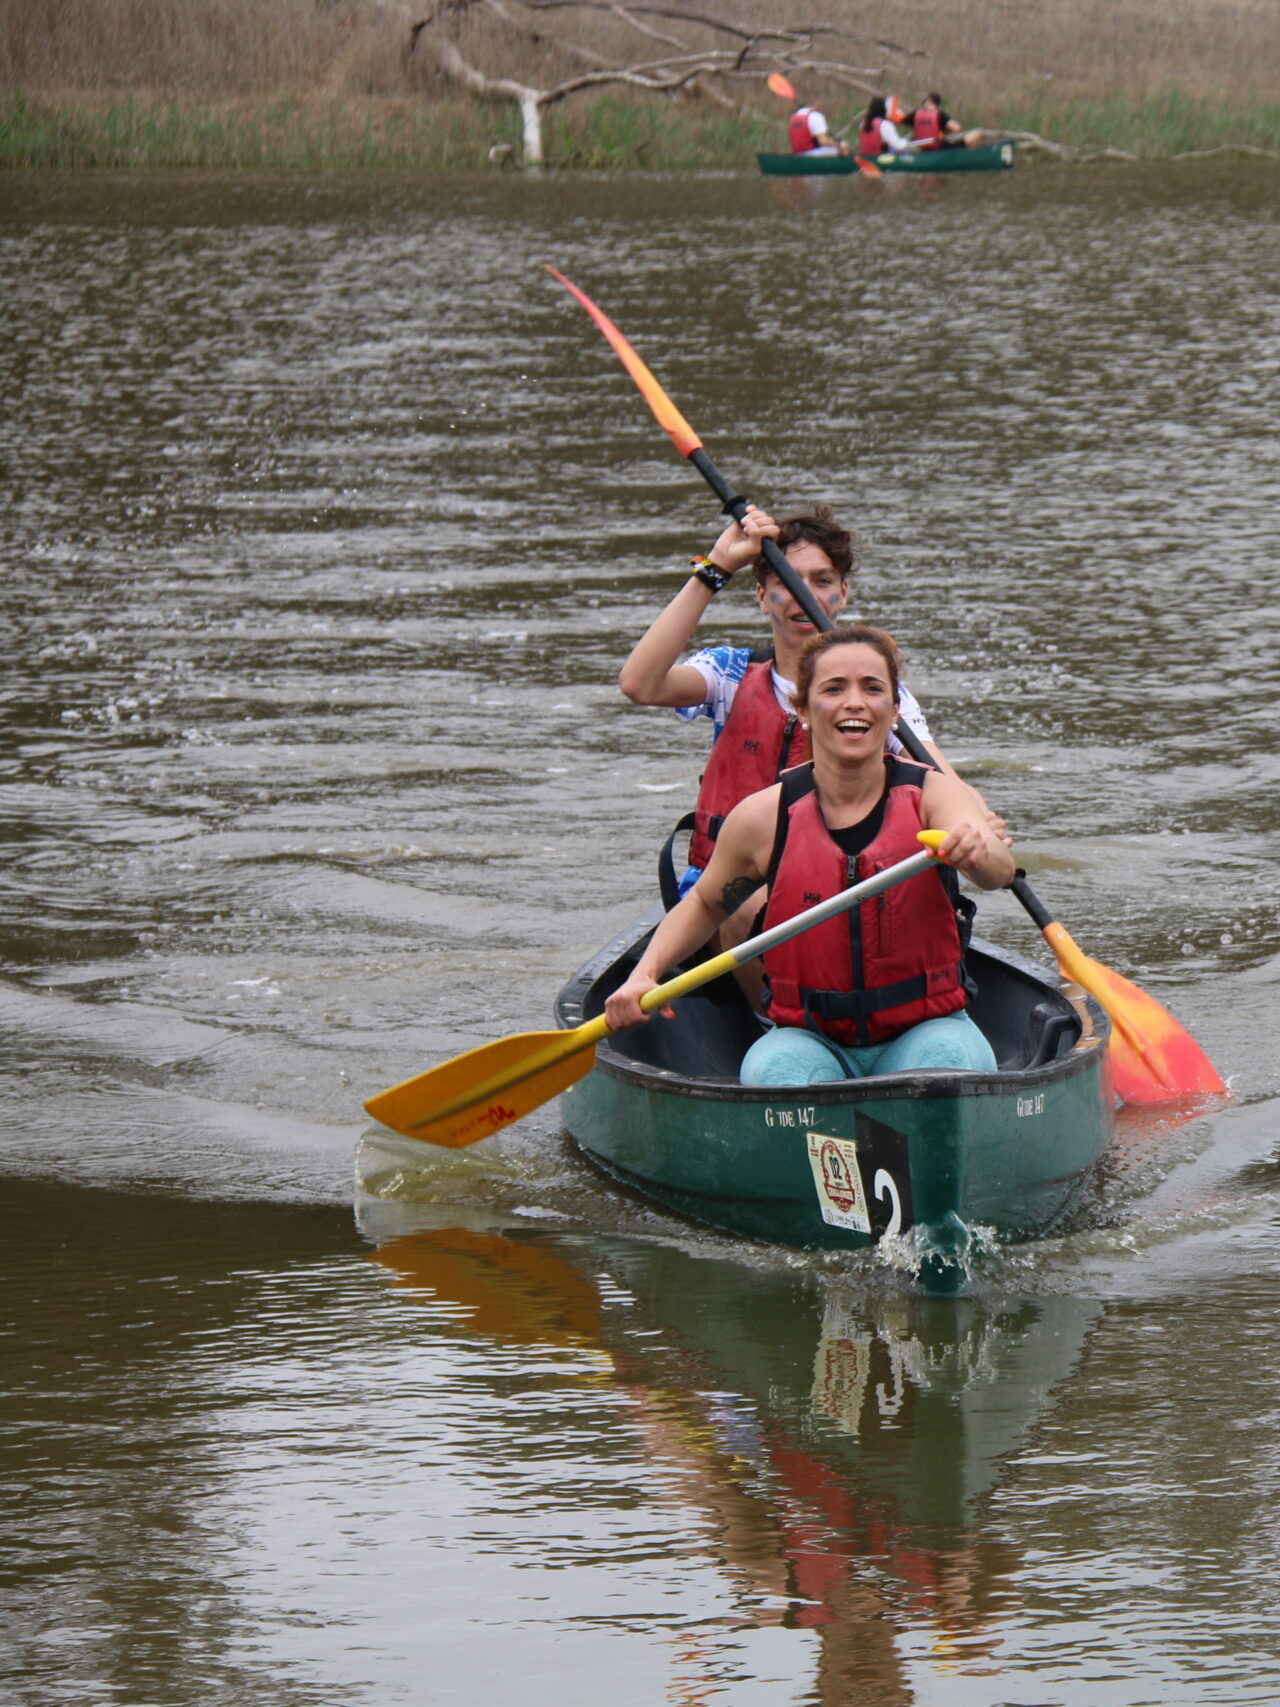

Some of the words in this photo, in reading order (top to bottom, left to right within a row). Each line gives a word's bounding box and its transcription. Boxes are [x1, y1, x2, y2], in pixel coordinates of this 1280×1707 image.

[764, 1107, 795, 1127] GIDE
[797, 1106, 815, 1126] 147
[874, 1168, 902, 1242] 2
